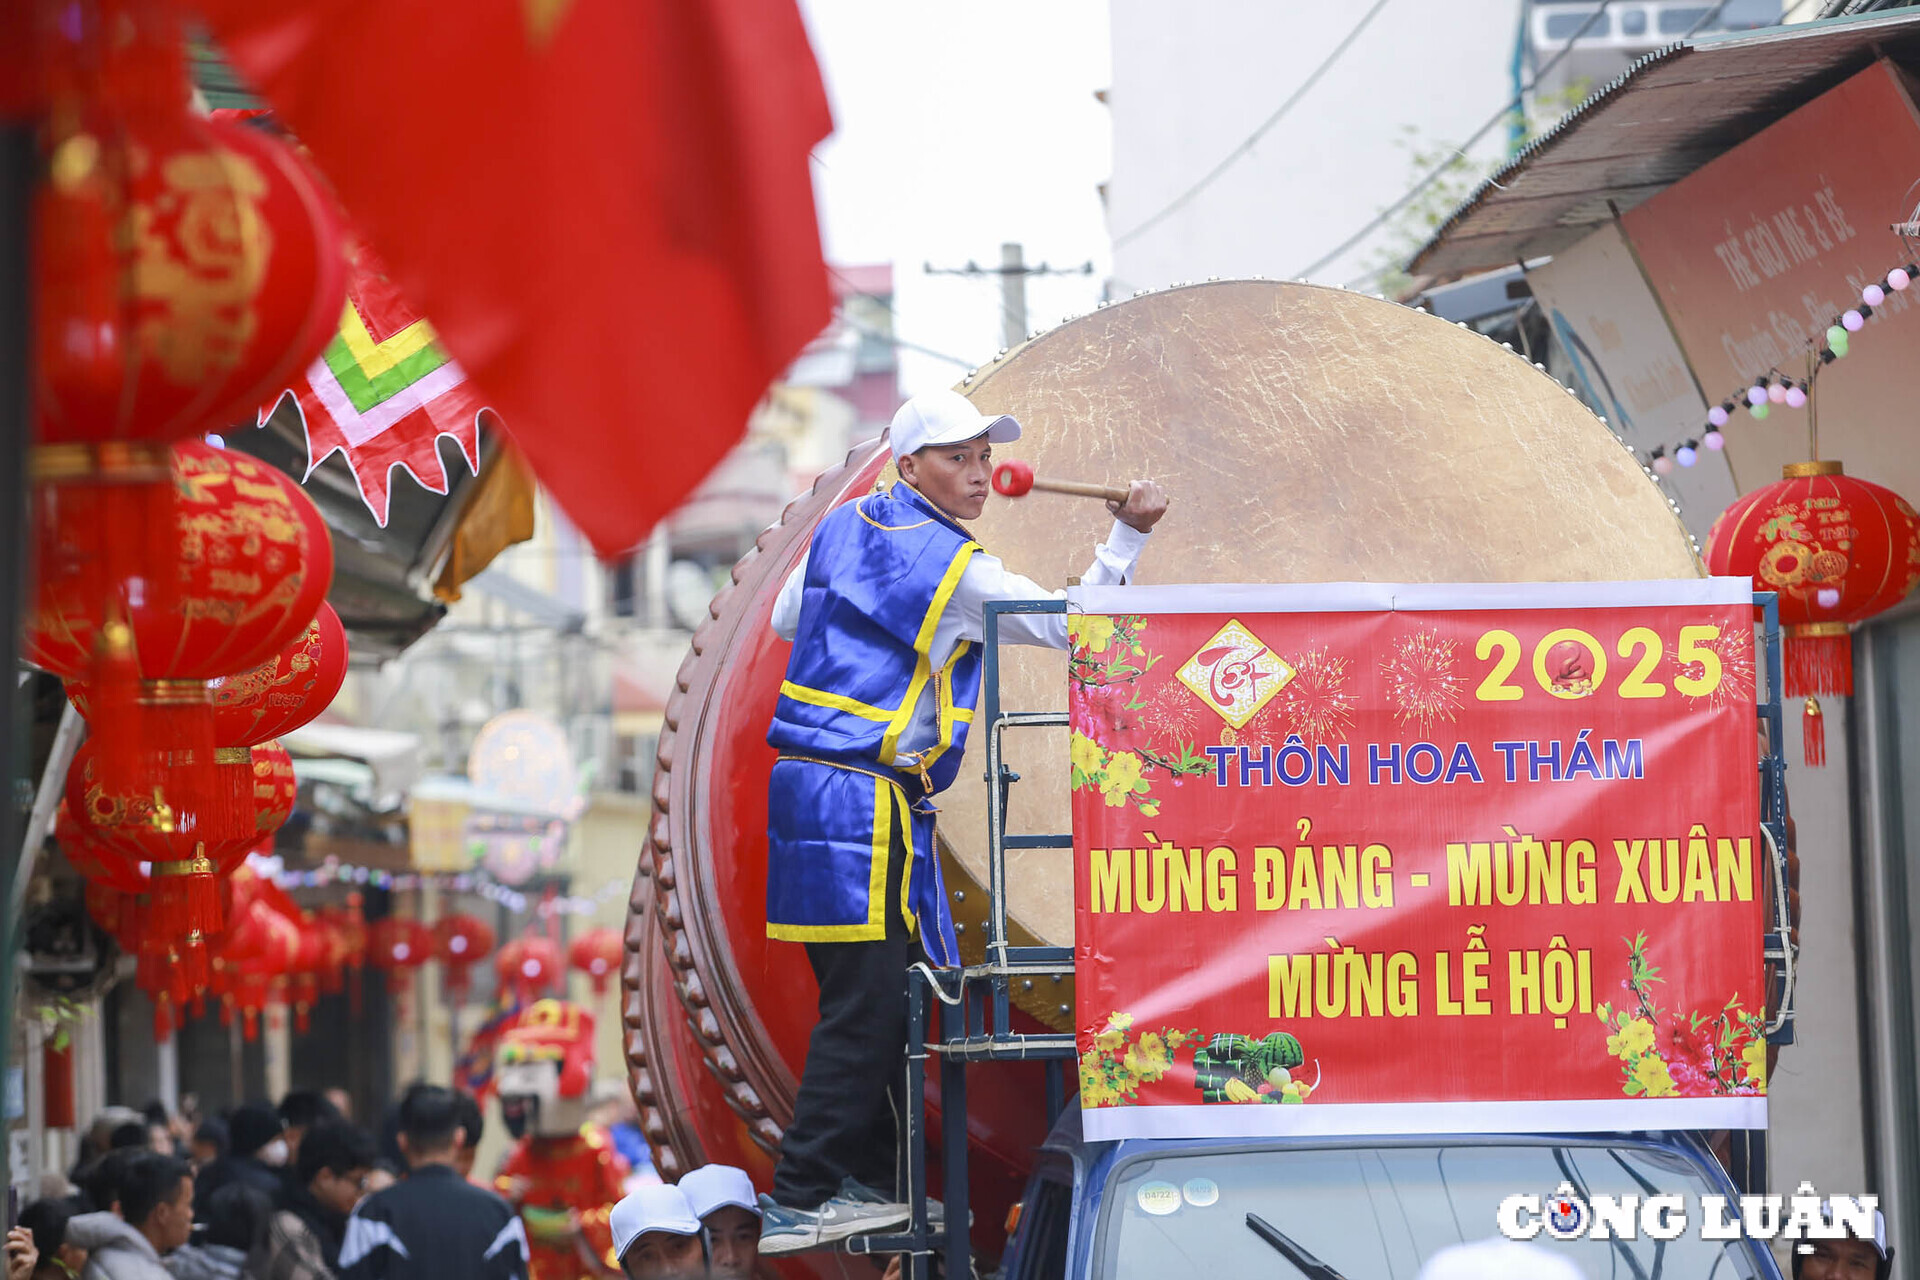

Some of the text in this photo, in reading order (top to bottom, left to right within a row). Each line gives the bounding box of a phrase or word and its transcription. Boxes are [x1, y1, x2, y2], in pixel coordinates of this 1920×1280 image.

[1803, 205, 1834, 251] &
[1814, 174, 1856, 242] BÉ
[1475, 625, 1723, 701] 2025
[1204, 729, 1644, 787] THÔN HOA THÁM
[1090, 817, 1755, 913] MỪNG ĐẢNG - MỪNG XUÂN
[1268, 924, 1594, 1030] MỪNG LỄ HỘI
